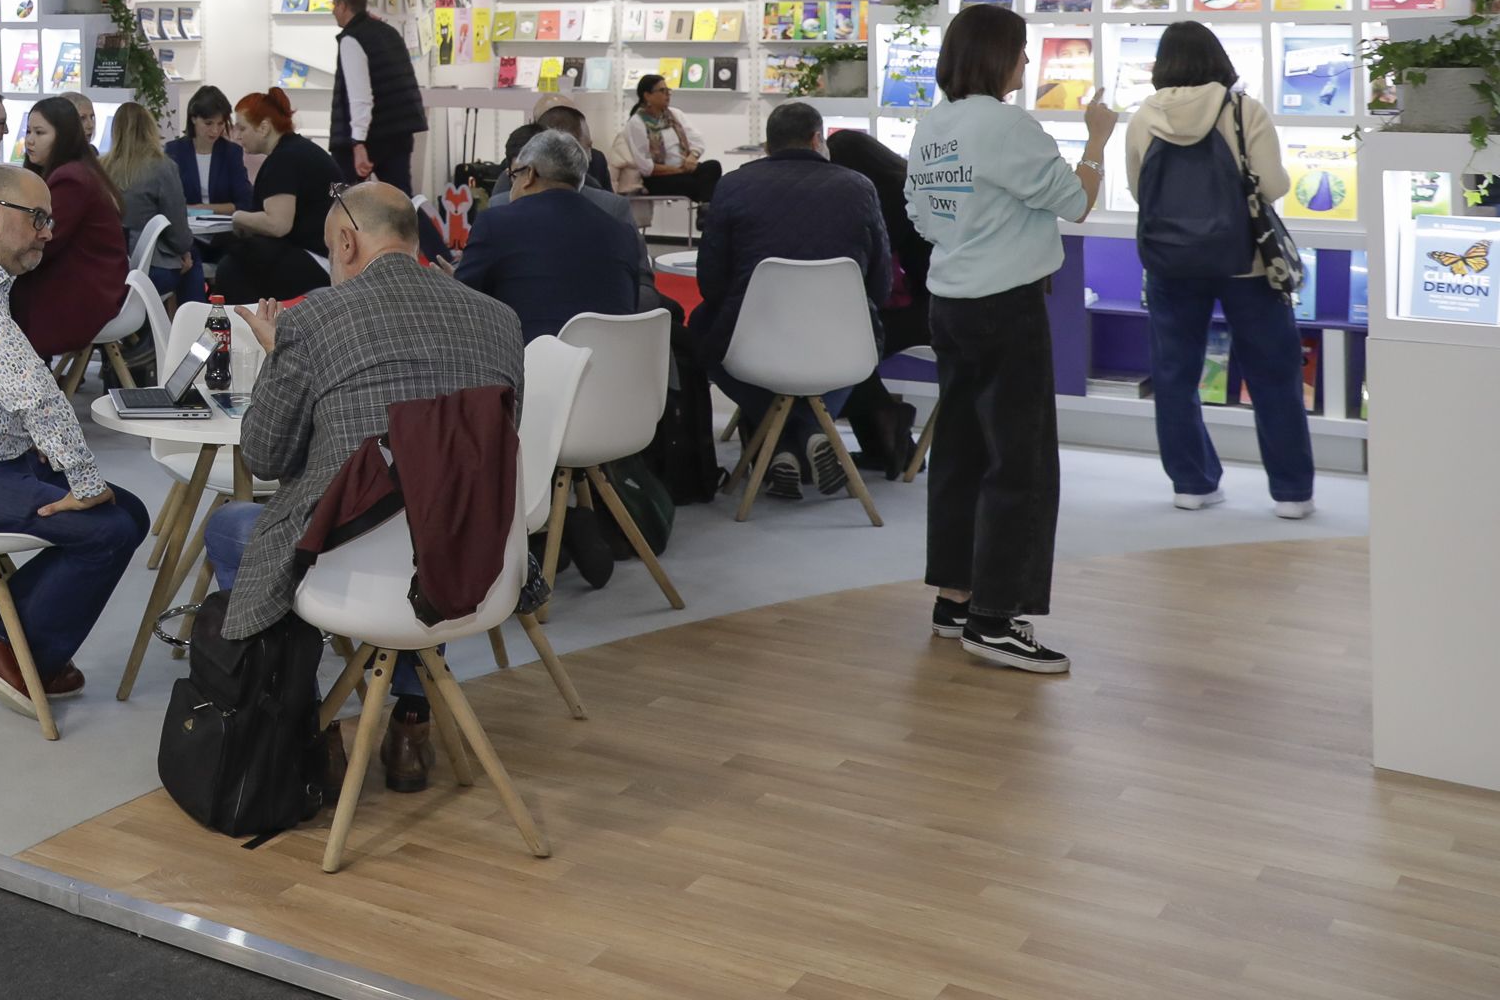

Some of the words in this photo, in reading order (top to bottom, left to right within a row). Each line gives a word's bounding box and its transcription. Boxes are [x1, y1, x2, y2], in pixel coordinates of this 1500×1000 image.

[920, 137, 958, 163] Where
[934, 165, 973, 185] world
[1423, 270, 1490, 287] CLIMATE
[1423, 281, 1490, 297] DEMON
